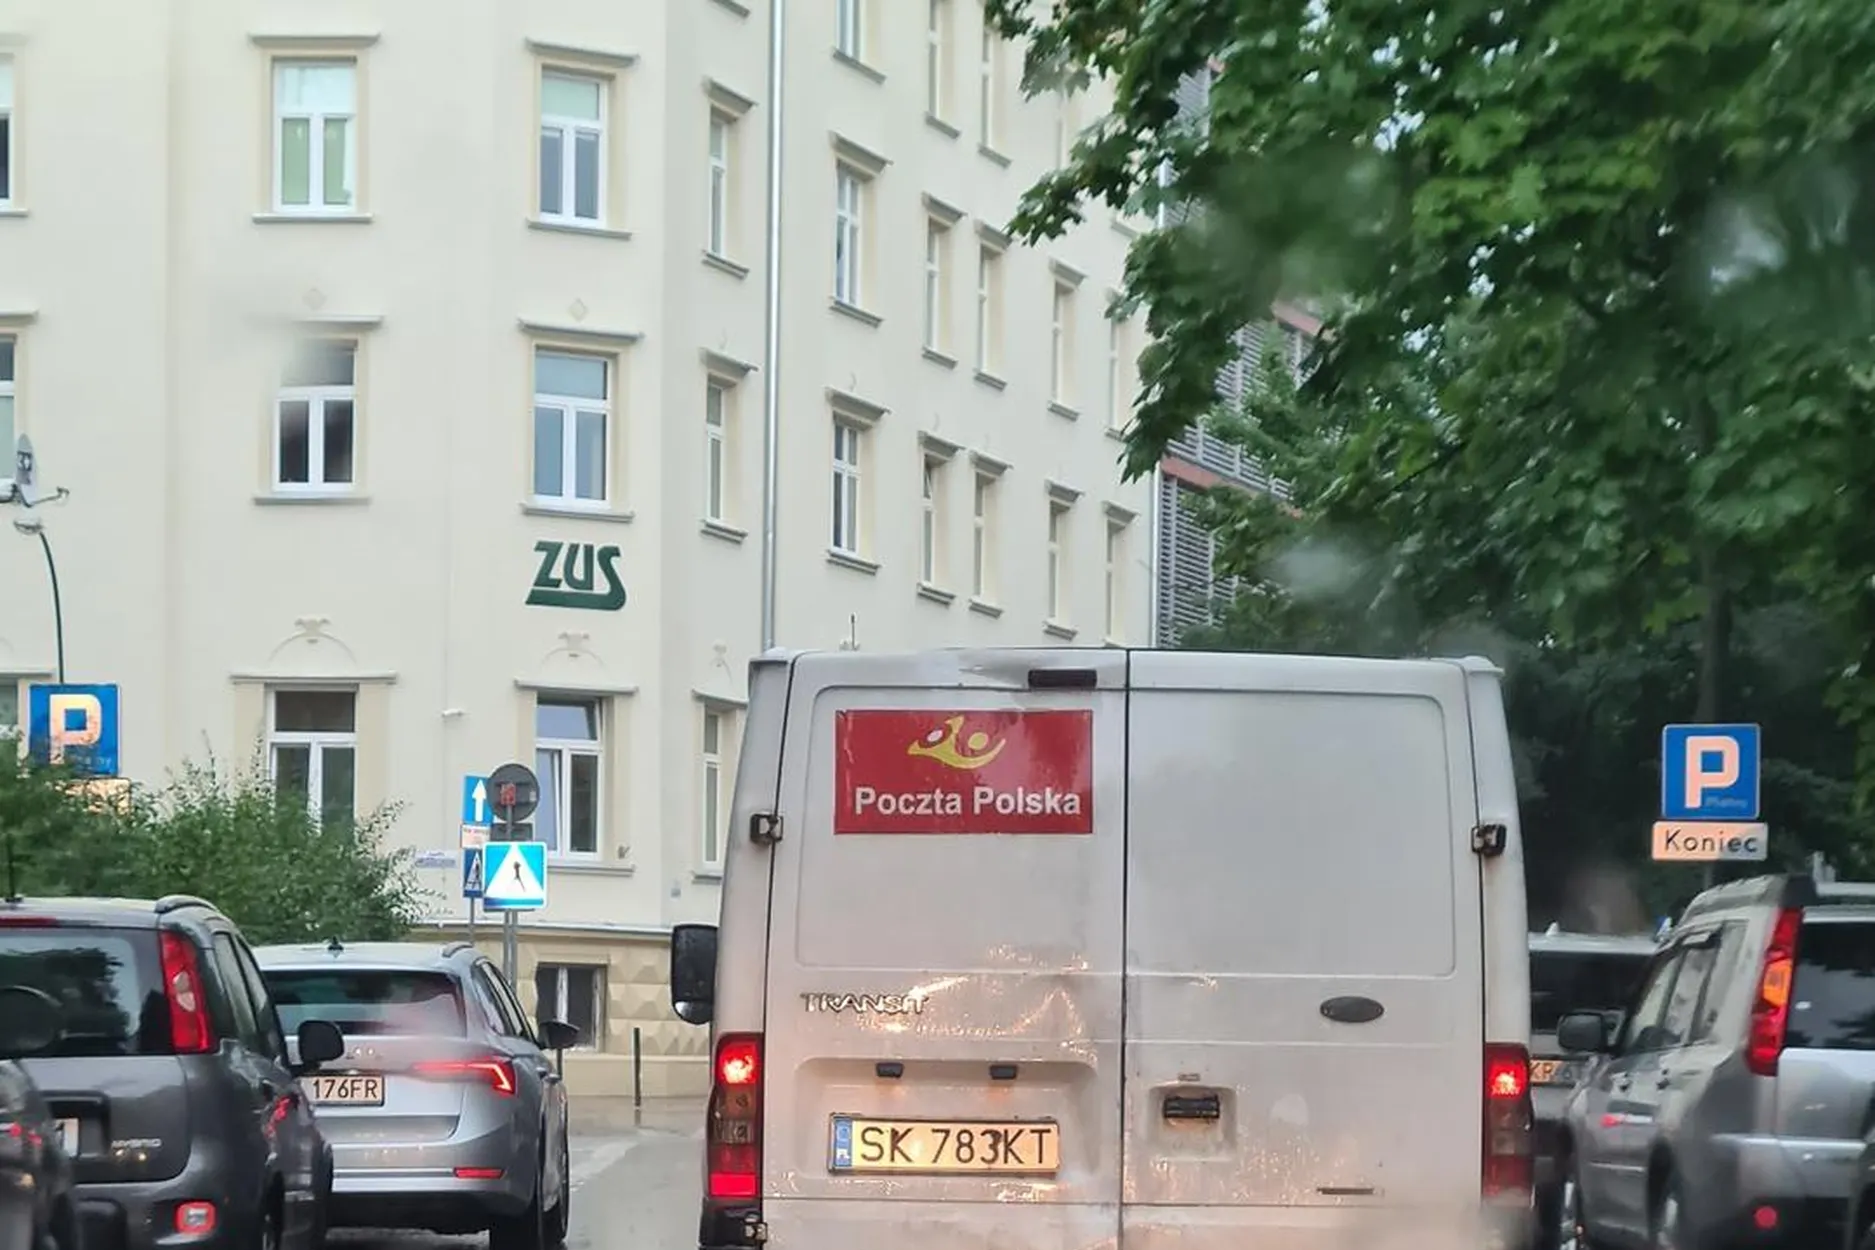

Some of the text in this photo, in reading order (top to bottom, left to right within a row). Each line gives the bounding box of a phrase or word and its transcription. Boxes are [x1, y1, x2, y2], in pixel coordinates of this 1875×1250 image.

[524, 539, 627, 612] ZUS
[49, 693, 102, 765] P
[1684, 735, 1740, 809] P
[854, 785, 1081, 815] Poczta Polska
[1664, 828, 1759, 853] Koniec
[800, 993, 929, 1015] TRANSIT
[312, 1078, 378, 1099] 176FR
[860, 1126, 1054, 1165] SK 783KT
